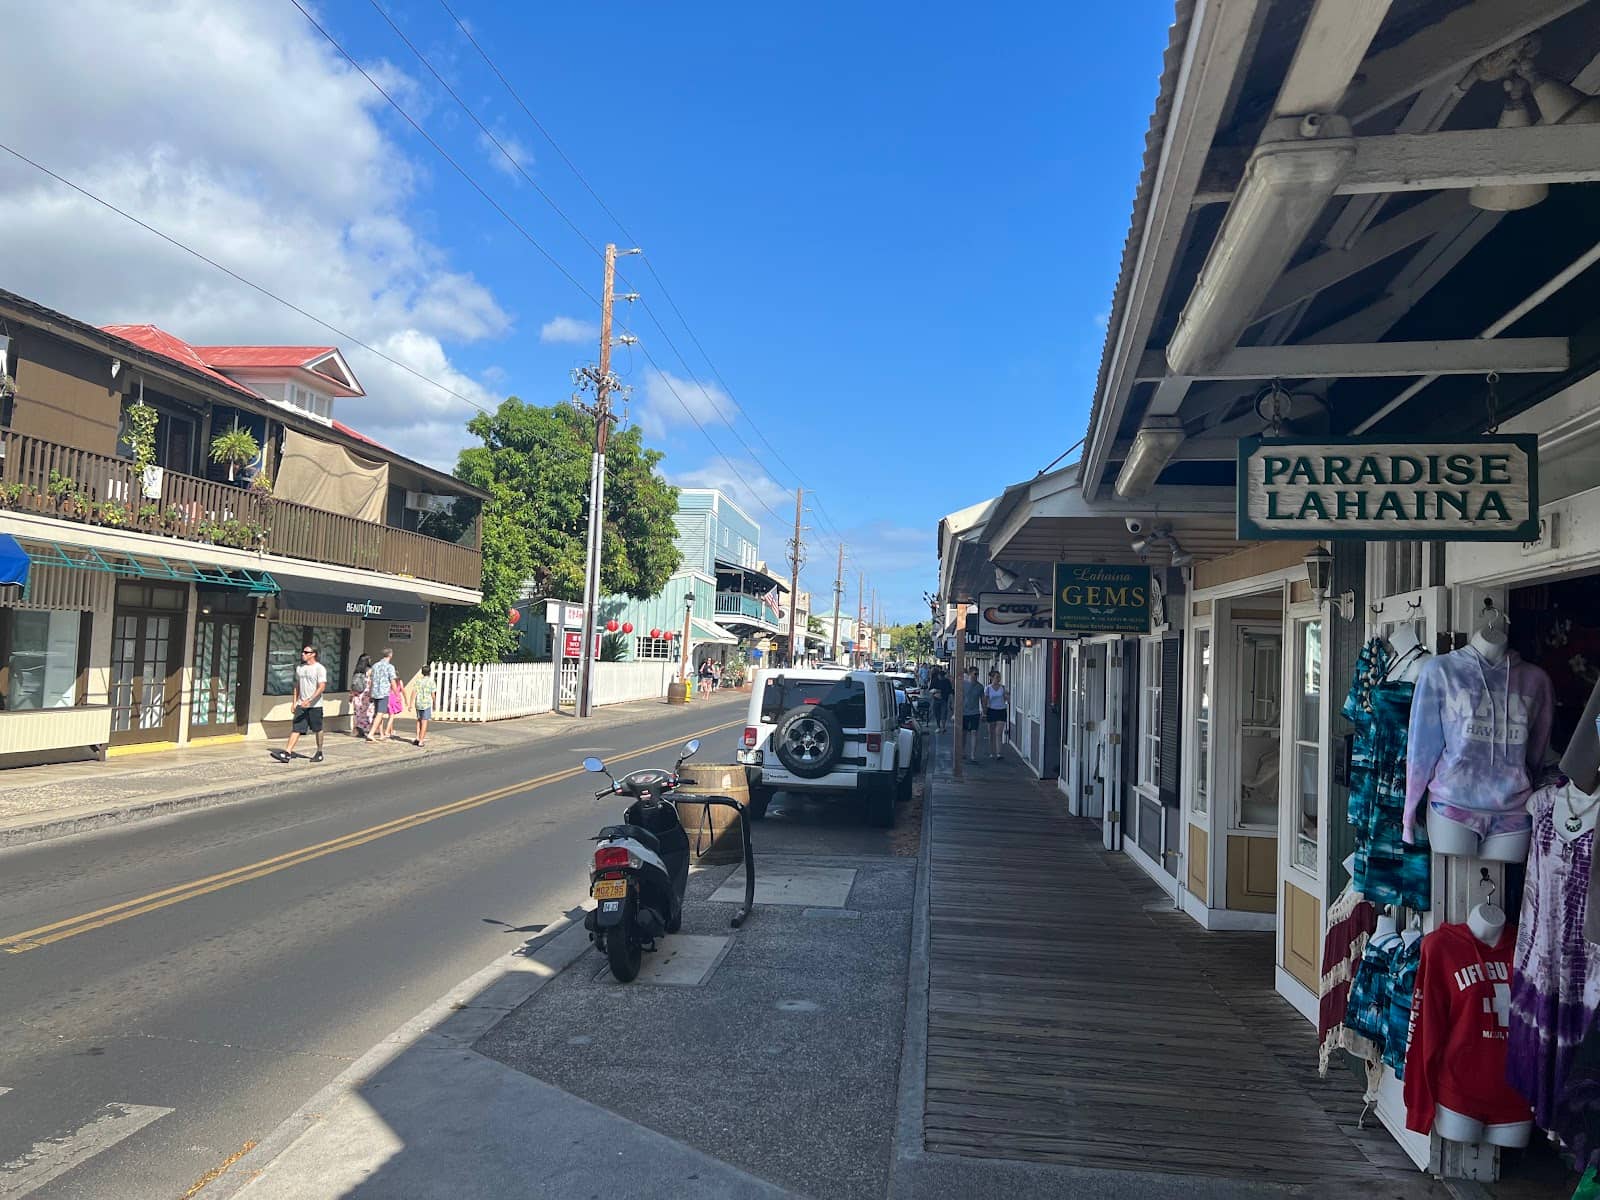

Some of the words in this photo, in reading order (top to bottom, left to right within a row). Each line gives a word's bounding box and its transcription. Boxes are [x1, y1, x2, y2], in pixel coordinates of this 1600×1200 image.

[1262, 454, 1511, 486] PARADISE
[1266, 490, 1512, 521] LAHAINA
[1073, 567, 1131, 581] Lahaina
[1062, 585, 1145, 607] GEMS
[1454, 962, 1510, 992] LIFGU
